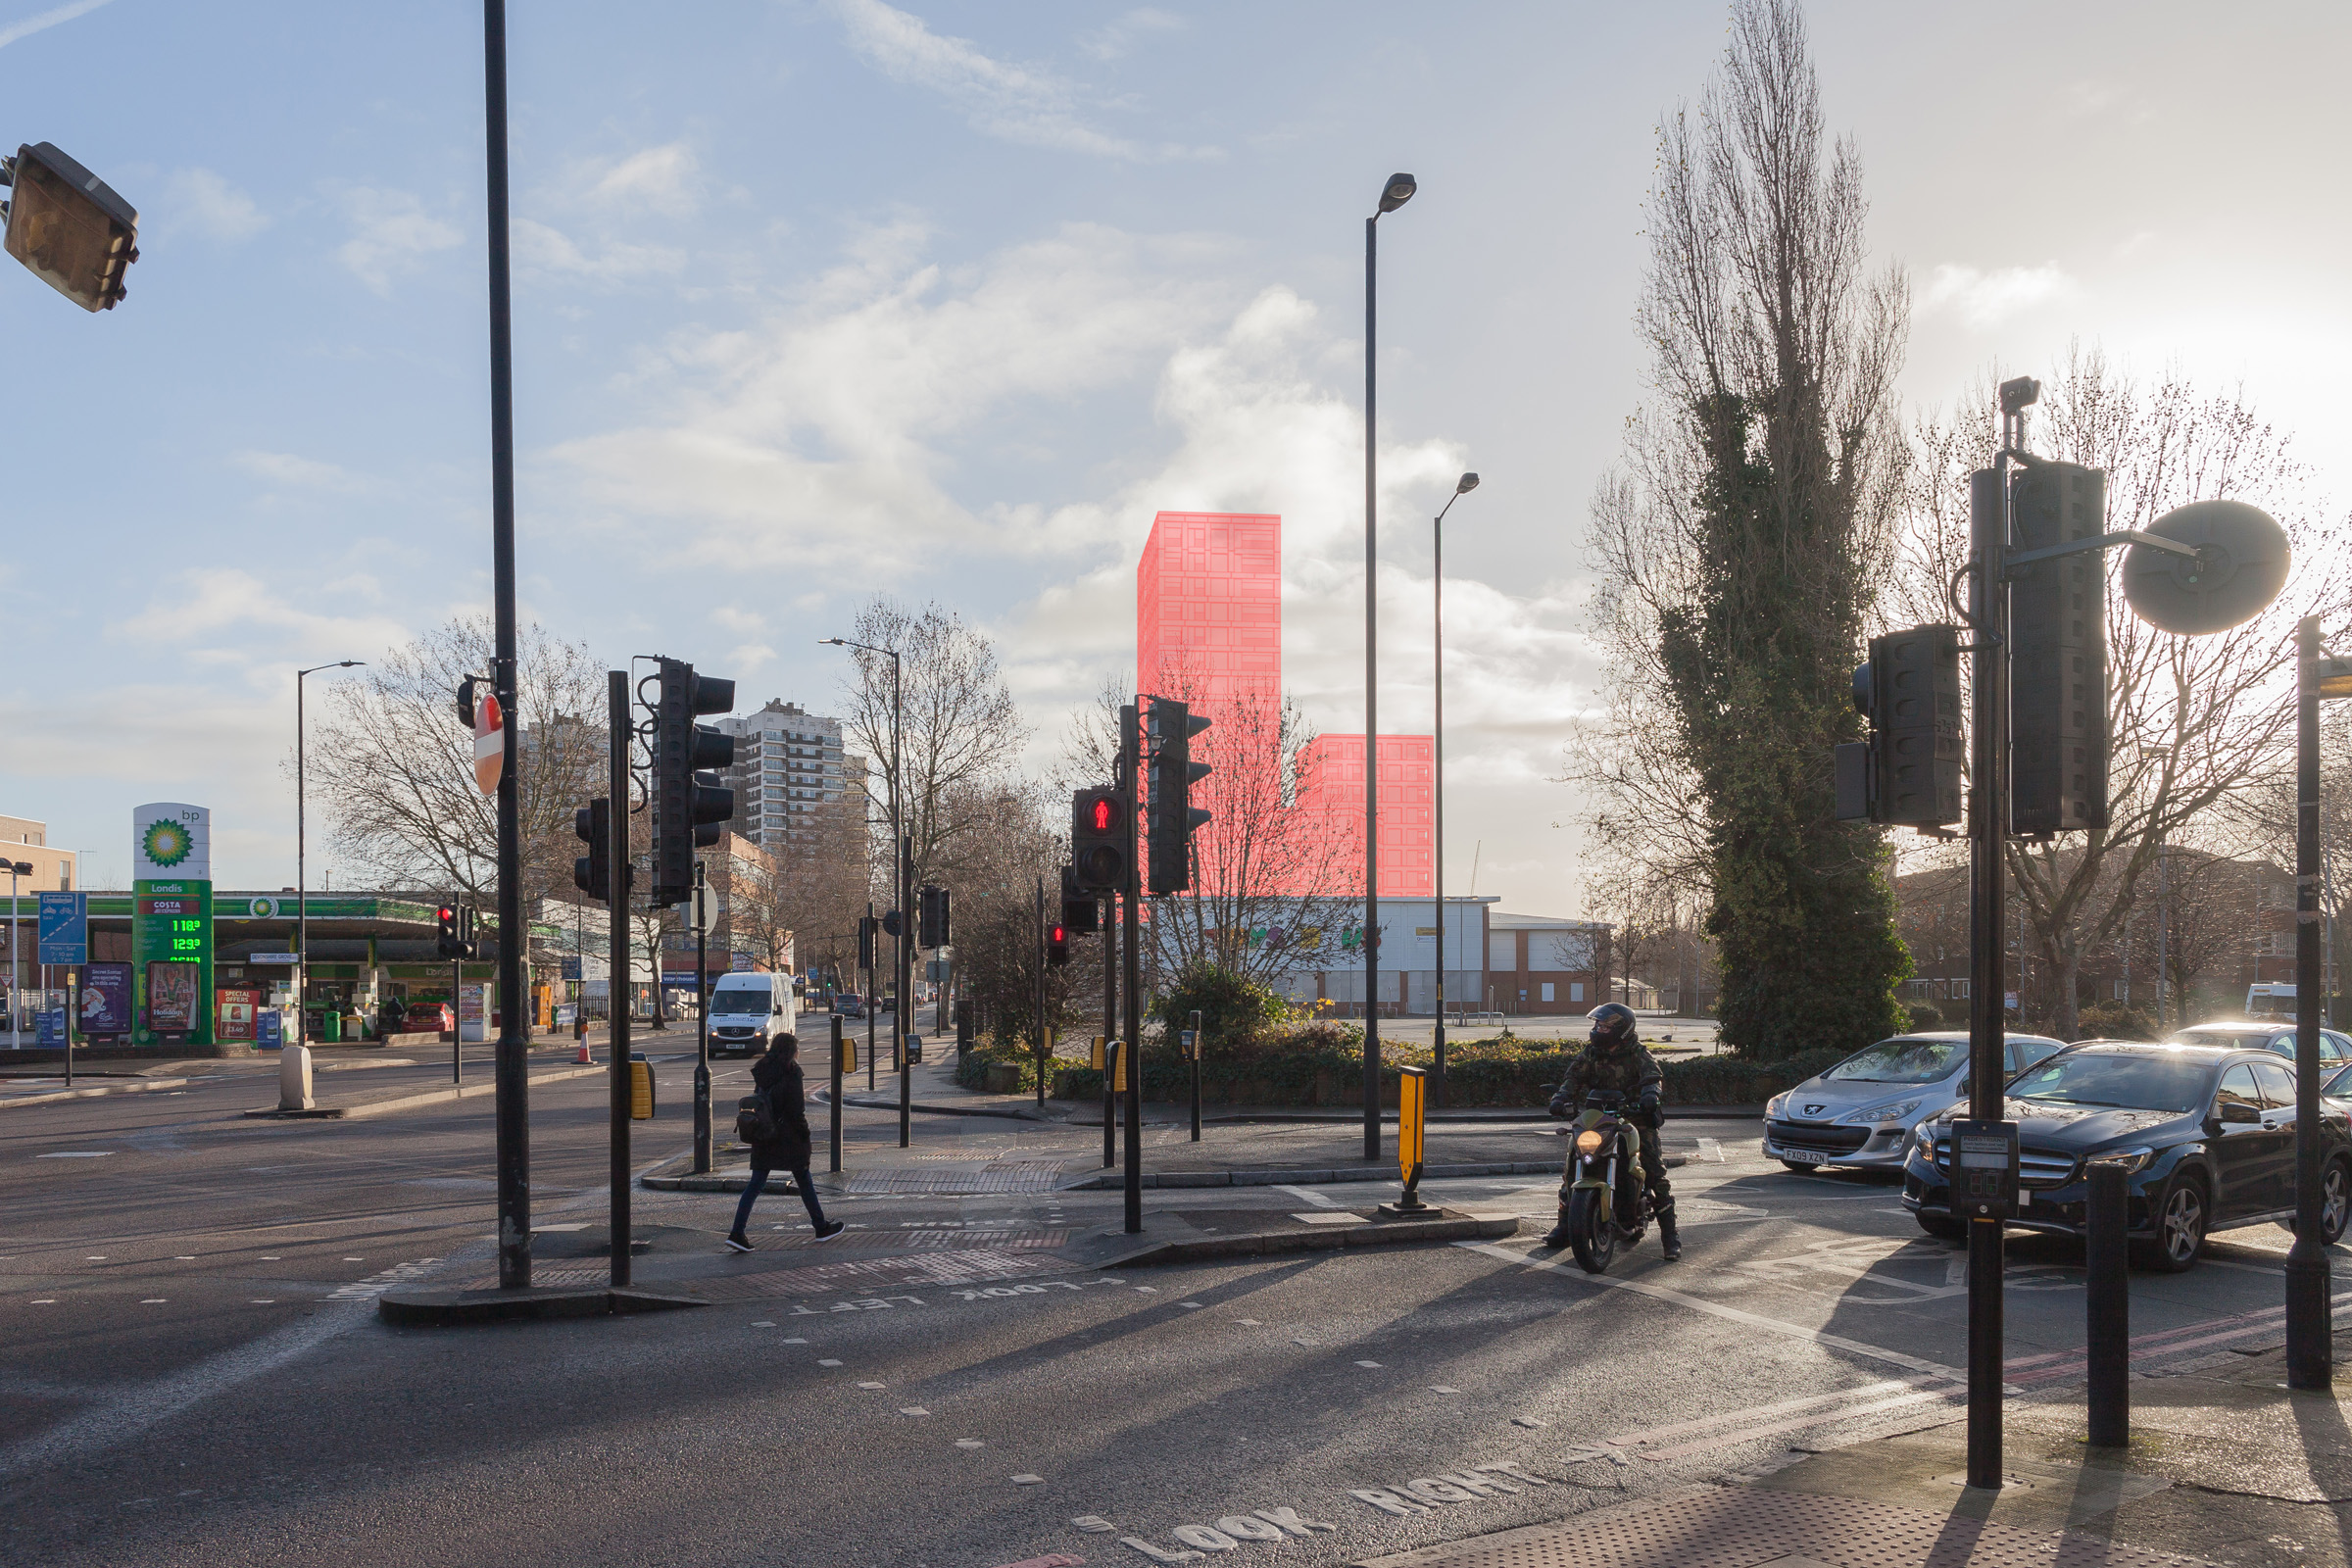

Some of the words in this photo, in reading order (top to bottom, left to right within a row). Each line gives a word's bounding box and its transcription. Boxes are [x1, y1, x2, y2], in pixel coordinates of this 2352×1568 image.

[181, 809, 200, 822] bp
[151, 884, 182, 893] Londis
[172, 938, 201, 950] 129.9
[1786, 1150, 1807, 1160] FX09
[1808, 1152, 1825, 1162] XZN
[1120, 1506, 1337, 1564] LOOK
[1348, 1460, 1546, 1517] RIGHT
